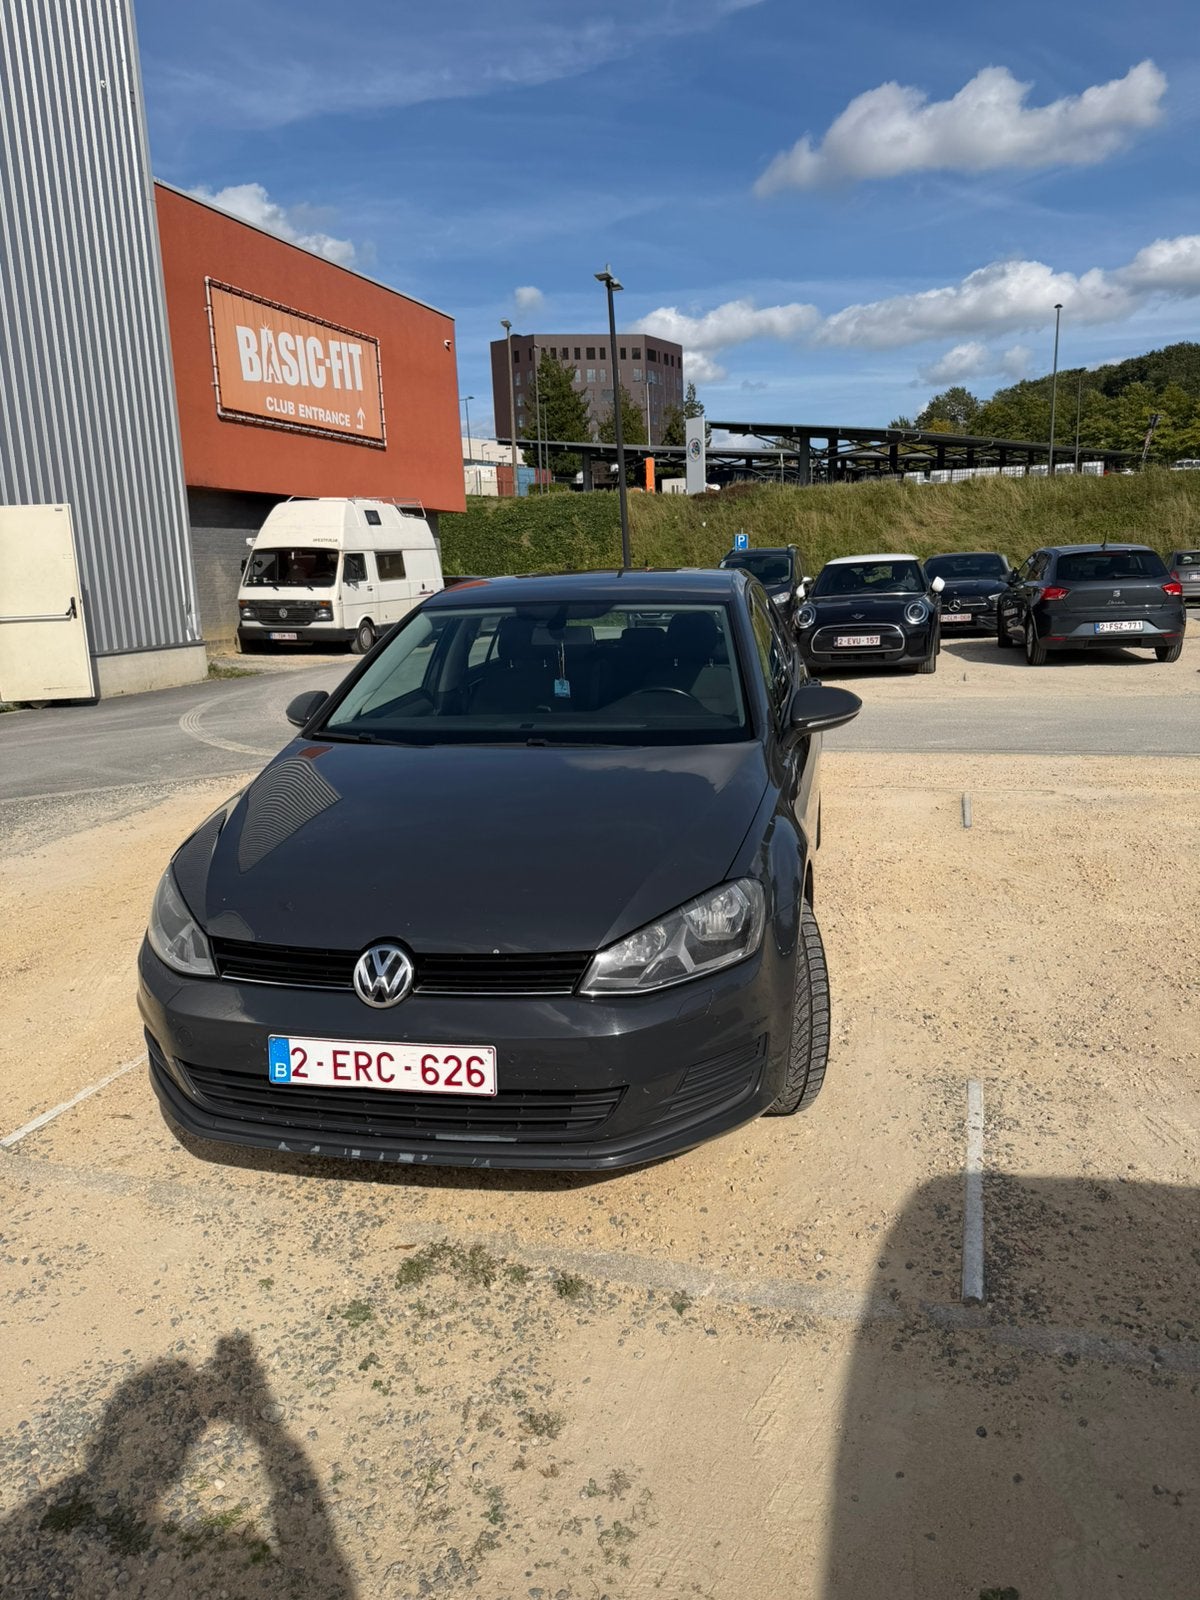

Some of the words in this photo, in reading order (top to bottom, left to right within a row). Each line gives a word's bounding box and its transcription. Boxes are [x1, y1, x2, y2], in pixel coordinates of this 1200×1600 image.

[236, 324, 363, 391] BASIC-FIT
[266, 397, 295, 415] CLUB
[299, 404, 351, 427] ENTRANCE
[838, 636, 879, 645] 2-EVU-157
[1100, 621, 1142, 631] 2-FSZ-771
[275, 1063, 287, 1077] B
[290, 1047, 486, 1088] 2-ERC-626
